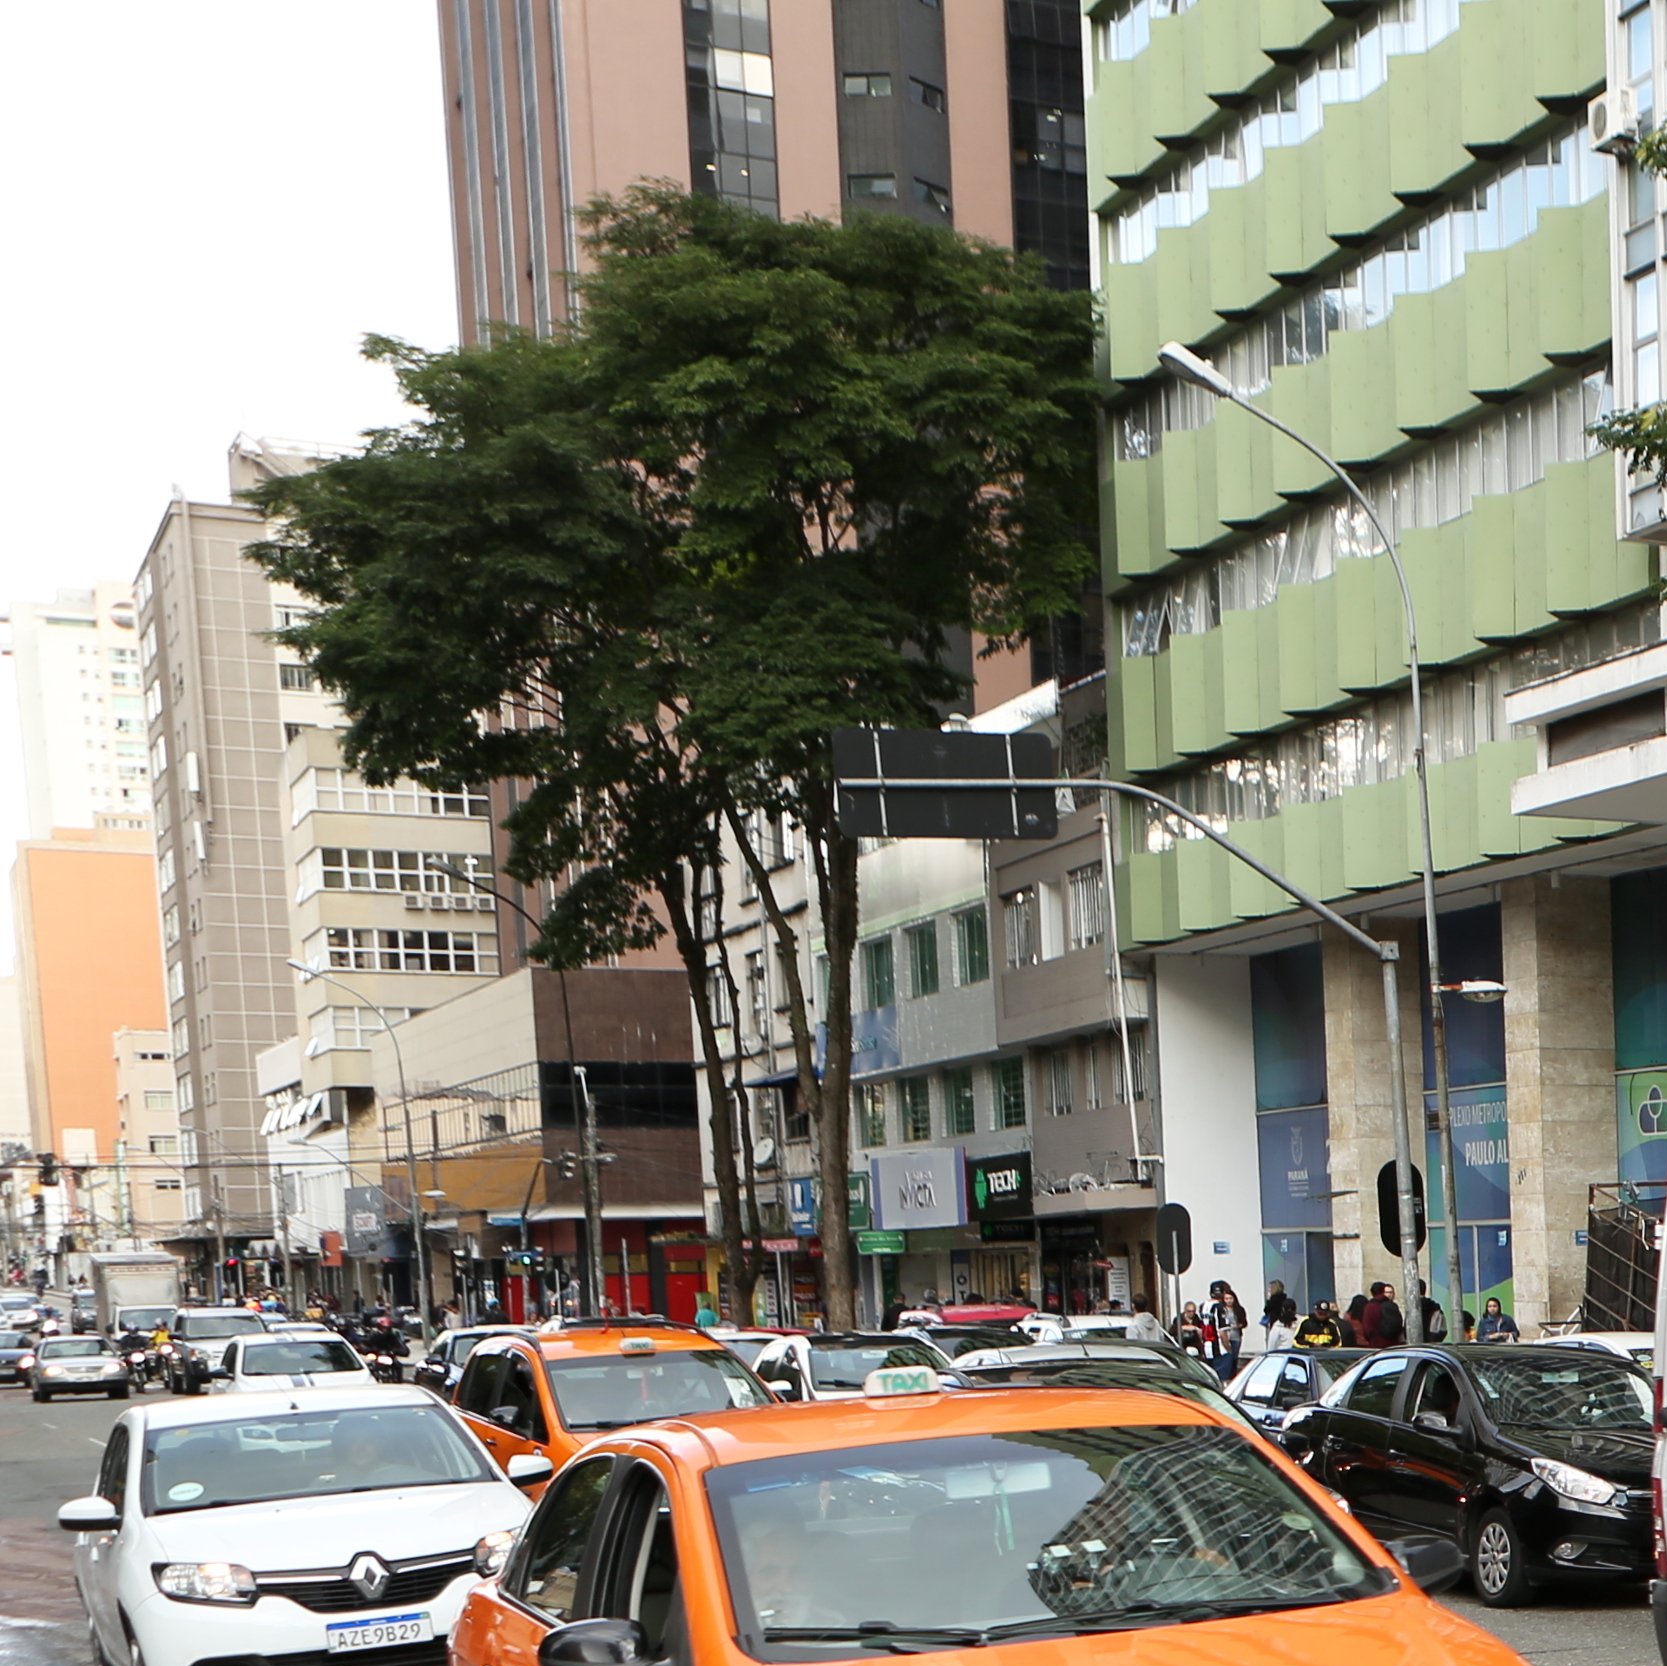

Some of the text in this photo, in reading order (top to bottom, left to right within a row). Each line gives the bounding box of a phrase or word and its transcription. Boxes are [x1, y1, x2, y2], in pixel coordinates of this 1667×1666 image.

[1472, 1101, 1507, 1125] METROPO
[1465, 1138, 1509, 1167] PAULO AL
[987, 1169, 1018, 1194] TECH
[1287, 1167, 1309, 1181] PARANÁ
[876, 1371, 929, 1393] TAXI
[337, 1622, 421, 1649] AZE9B29
